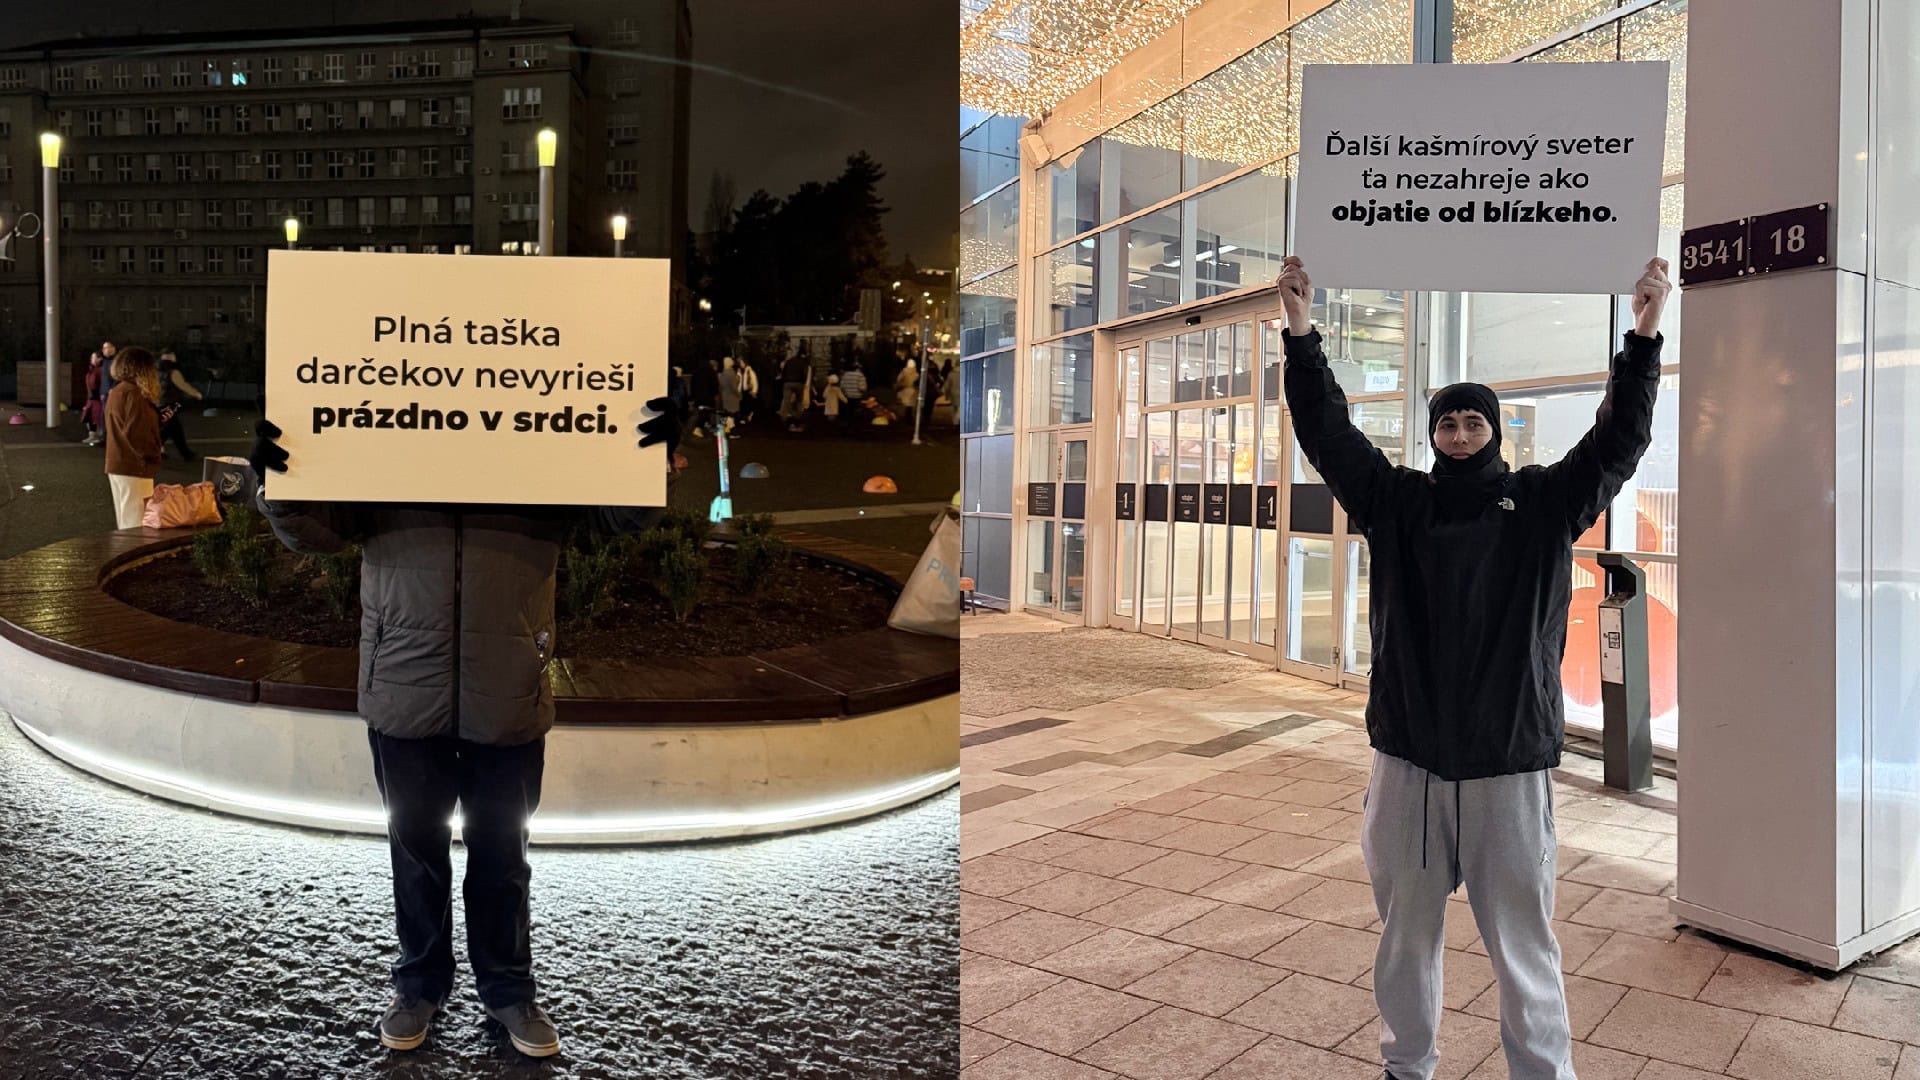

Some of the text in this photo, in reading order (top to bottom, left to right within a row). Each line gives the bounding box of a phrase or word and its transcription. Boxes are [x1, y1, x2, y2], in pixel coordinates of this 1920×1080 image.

[1326, 130, 1635, 161] Ďalší kašmírový sveter
[1361, 167, 1590, 195] ťa nezahreje ako
[1331, 198, 1618, 227] objatie od blízkeho.
[1683, 236, 1744, 270] 3541
[1770, 224, 1806, 256] 18
[374, 315, 561, 347] Plná taška
[296, 356, 635, 397] darčekov nevyrieši
[312, 400, 619, 435] prázdno v srdci.
